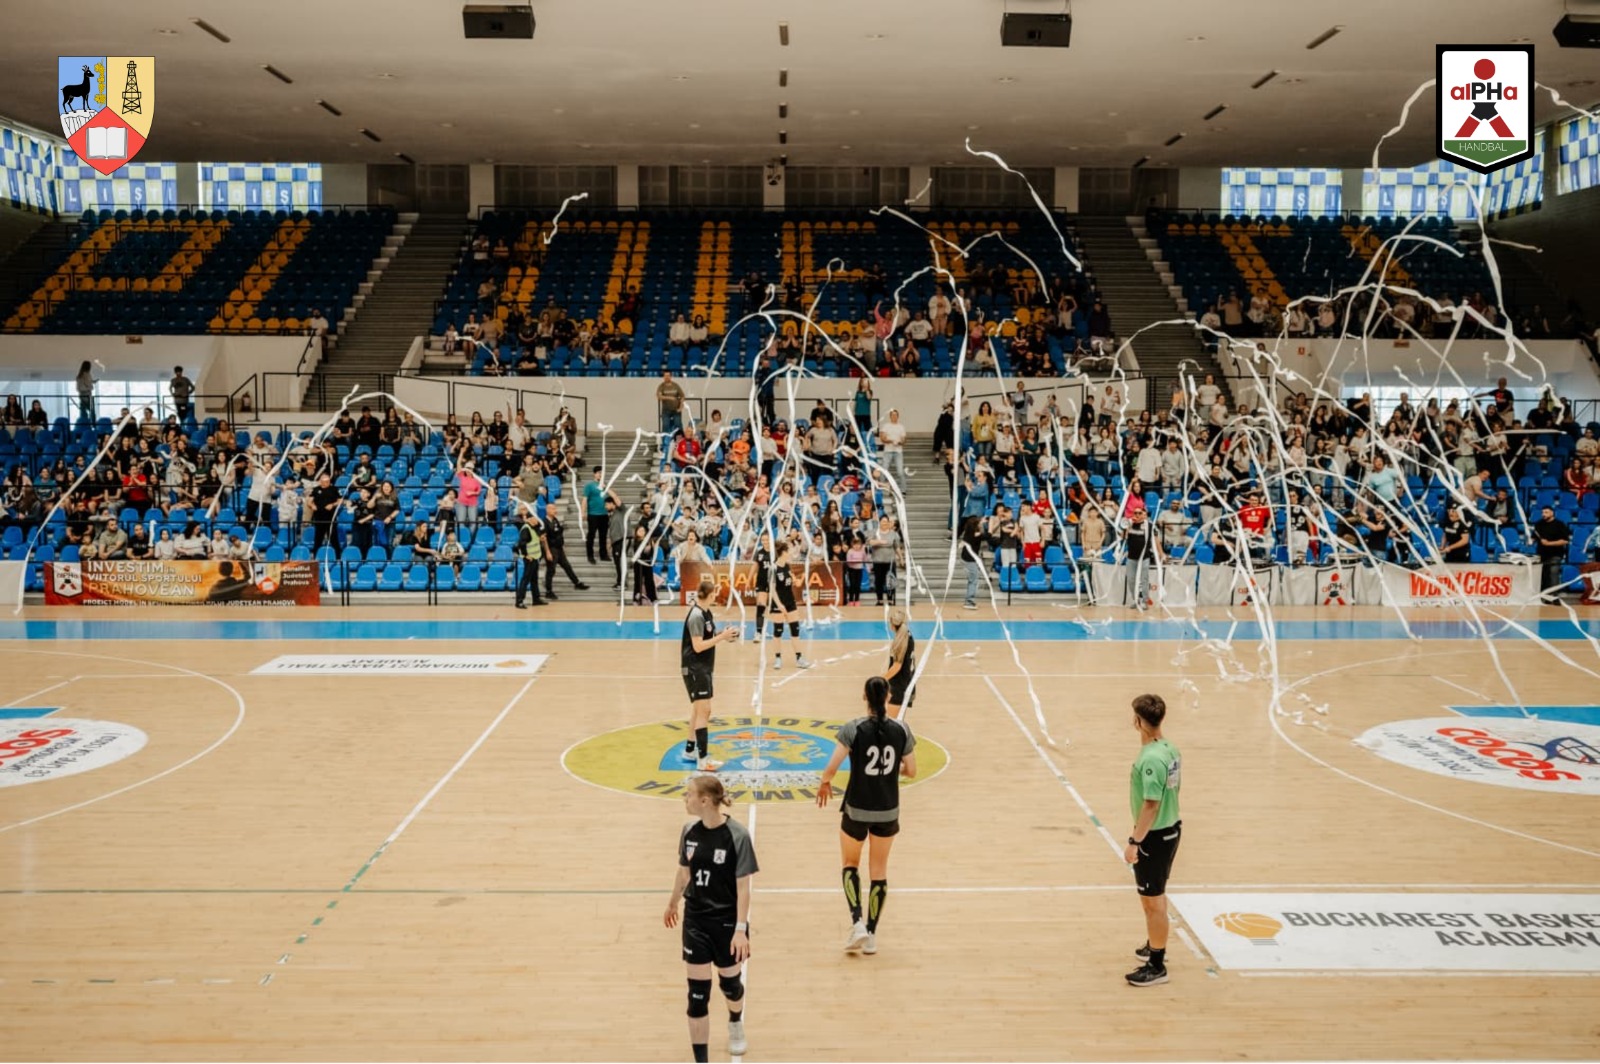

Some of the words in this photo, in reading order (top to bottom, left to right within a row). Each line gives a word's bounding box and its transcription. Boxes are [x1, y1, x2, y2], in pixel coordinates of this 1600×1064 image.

[88, 560, 164, 573] INVESTIM
[88, 573, 137, 582] VIITORUL
[141, 574, 202, 583] SPORTULUI
[1464, 571, 1511, 596] Class
[89, 583, 194, 596] PRAHOVEAN
[865, 745, 896, 777] 29
[695, 868, 711, 887] 17
[1282, 912, 1482, 928] BUCHAREST
